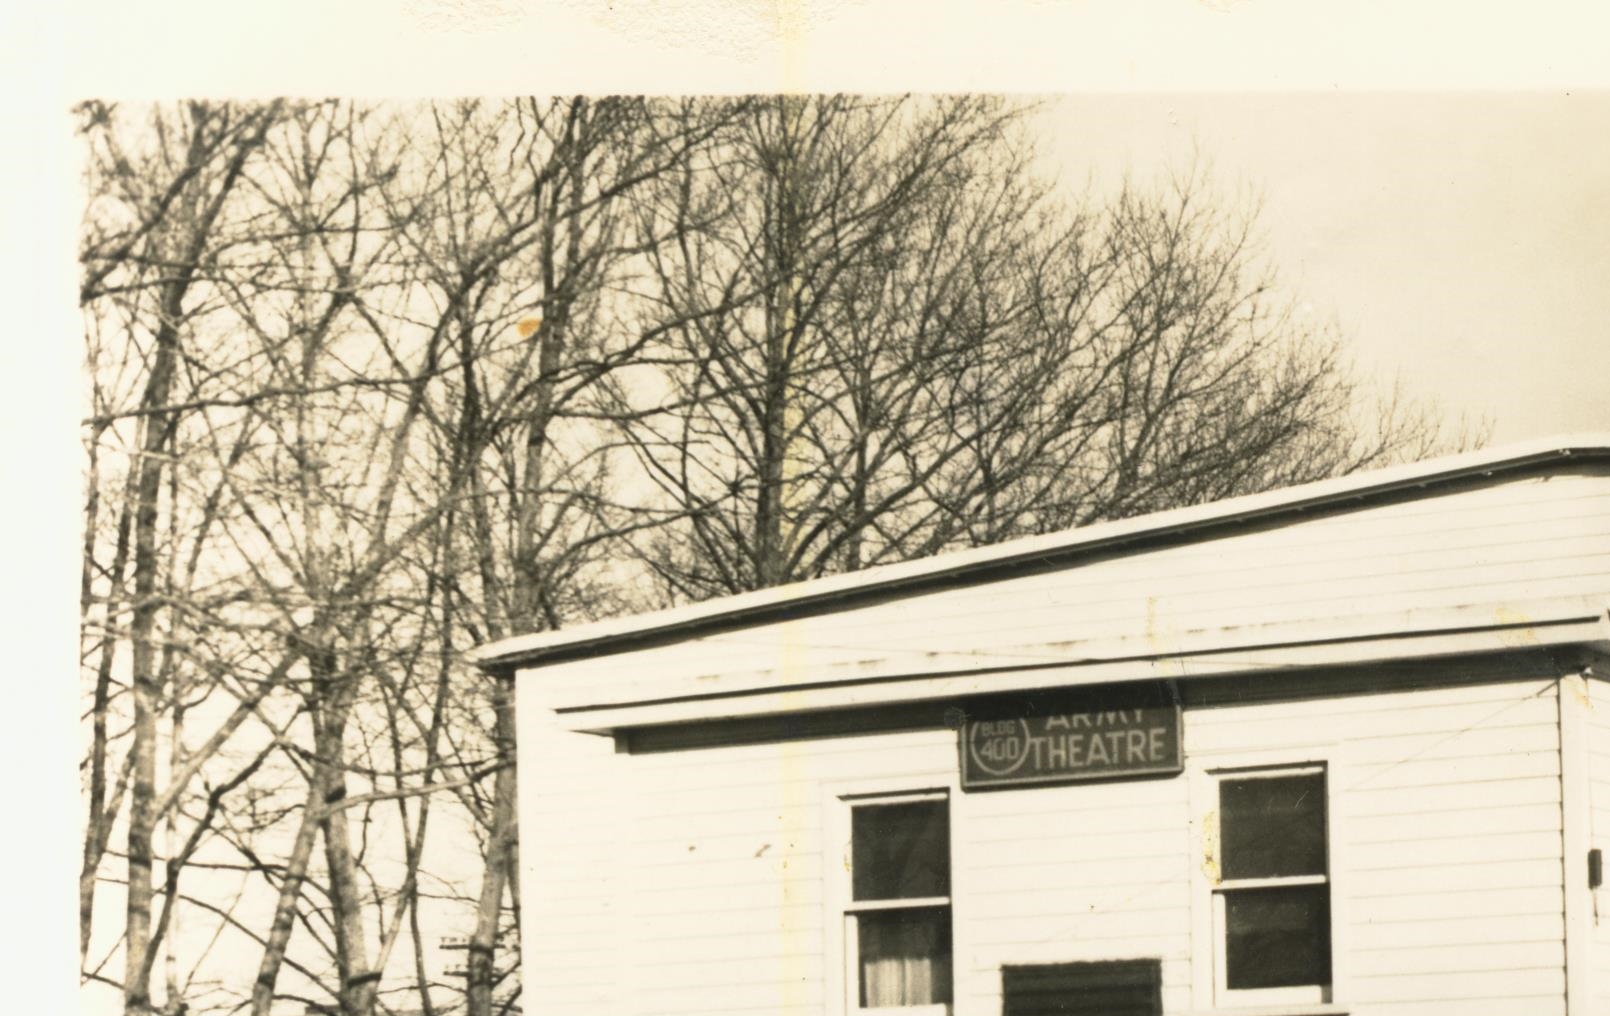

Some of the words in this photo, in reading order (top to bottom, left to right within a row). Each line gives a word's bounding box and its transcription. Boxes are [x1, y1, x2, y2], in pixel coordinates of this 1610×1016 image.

[982, 721, 1015, 736] BLDG
[981, 737, 1019, 760] 400
[1030, 728, 1167, 770] THEATRE
